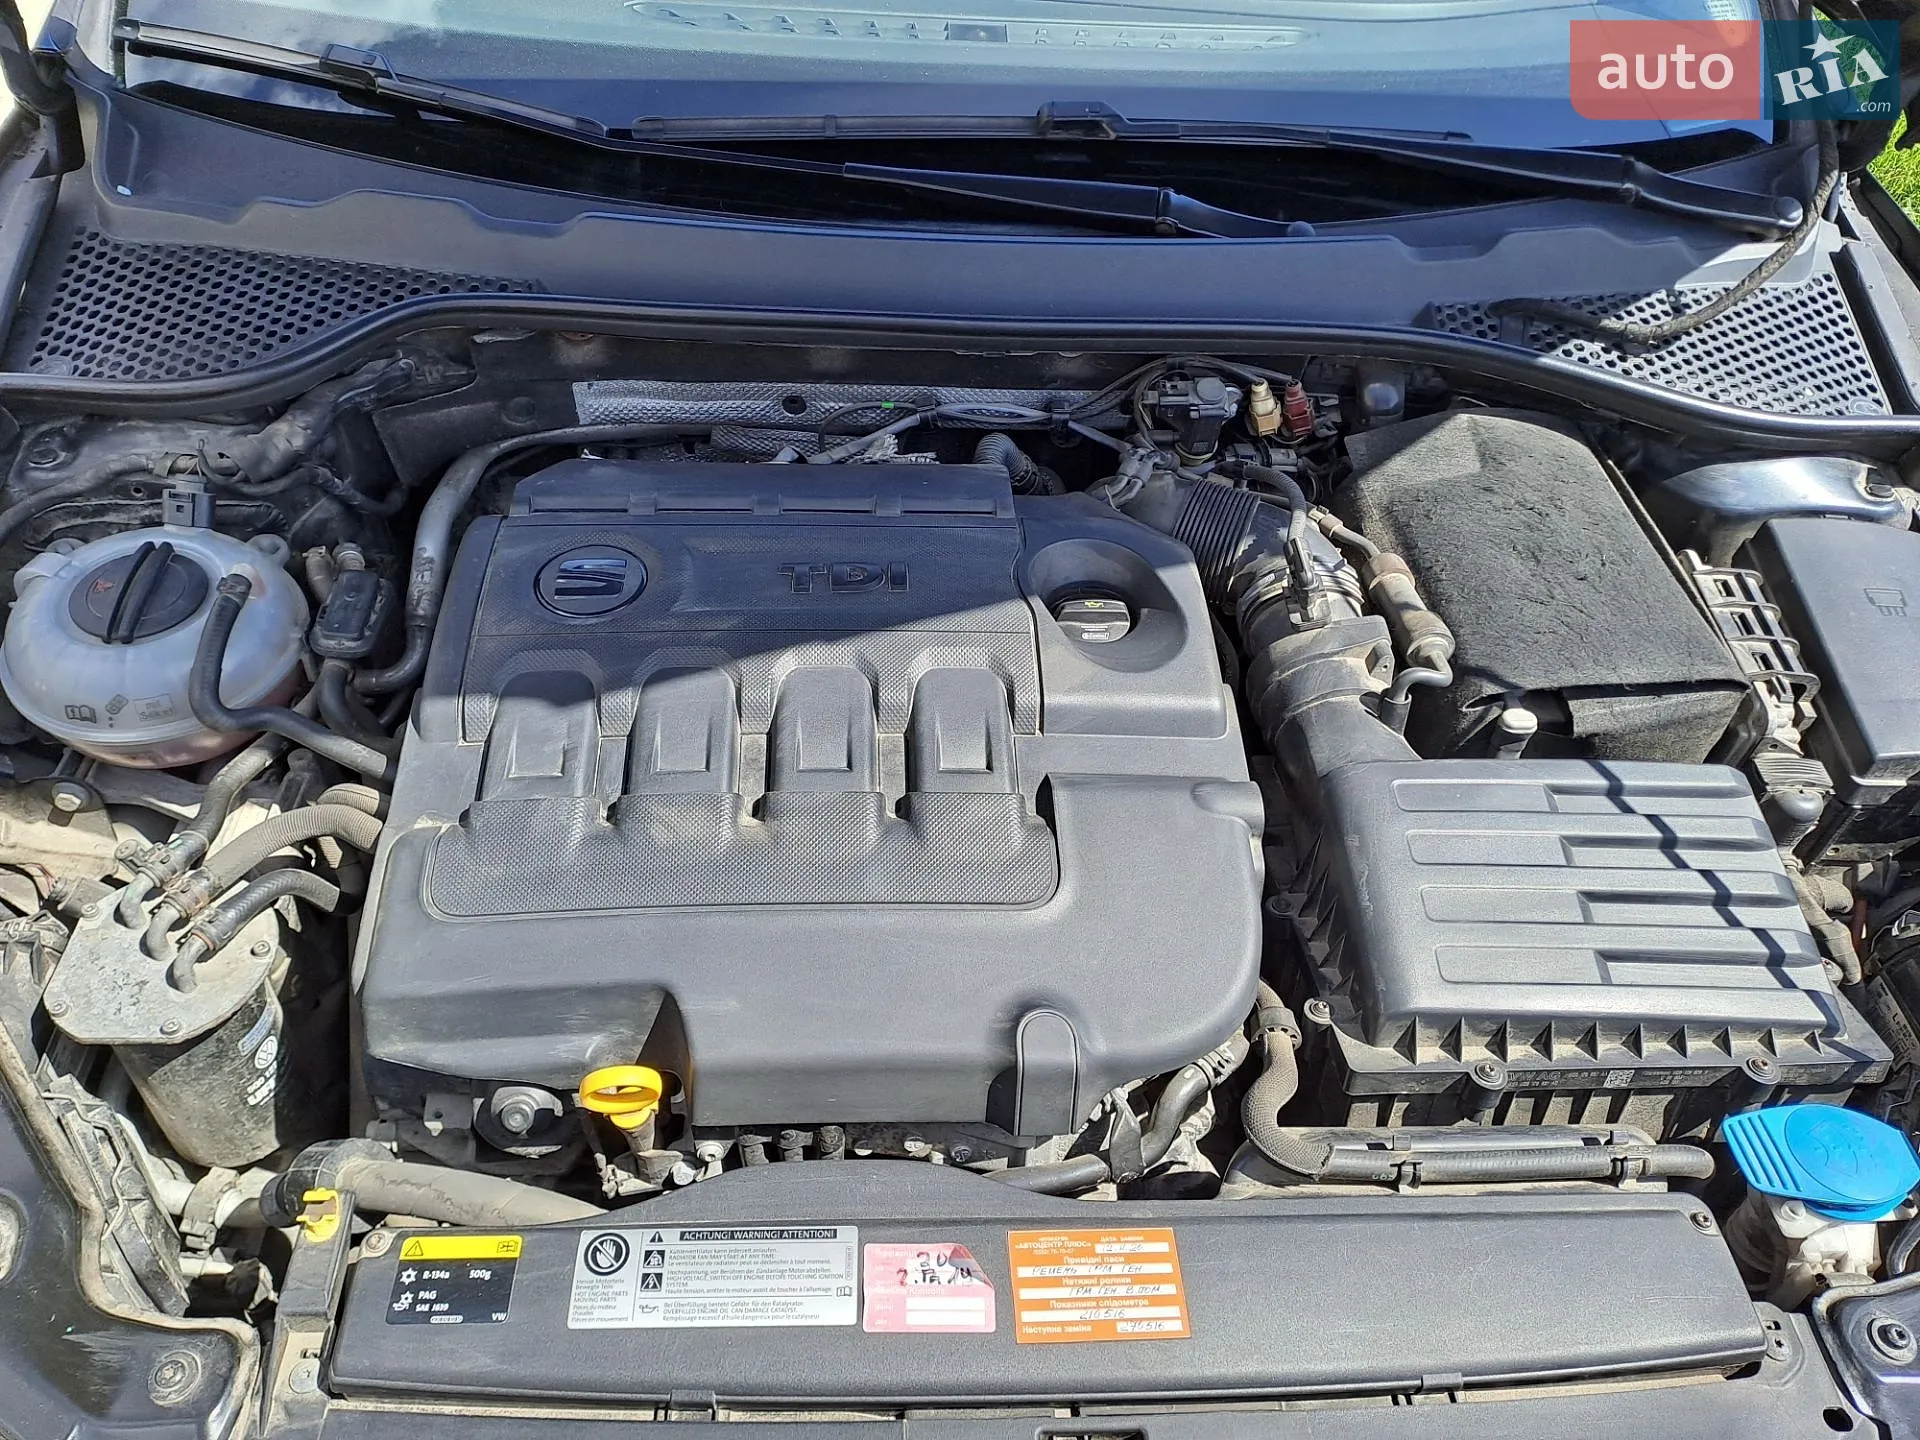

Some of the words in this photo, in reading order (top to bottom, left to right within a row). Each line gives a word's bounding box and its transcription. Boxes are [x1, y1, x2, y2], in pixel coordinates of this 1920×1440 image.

[776, 561, 910, 594] TDI
[683, 1231, 731, 1240] ACHTUNG!
[733, 1230, 781, 1240] WARNING!
[782, 1230, 834, 1239] ATTENTION!
[469, 1269, 492, 1280] 500g
[418, 1290, 437, 1300] PAG
[491, 1313, 507, 1321] VW
